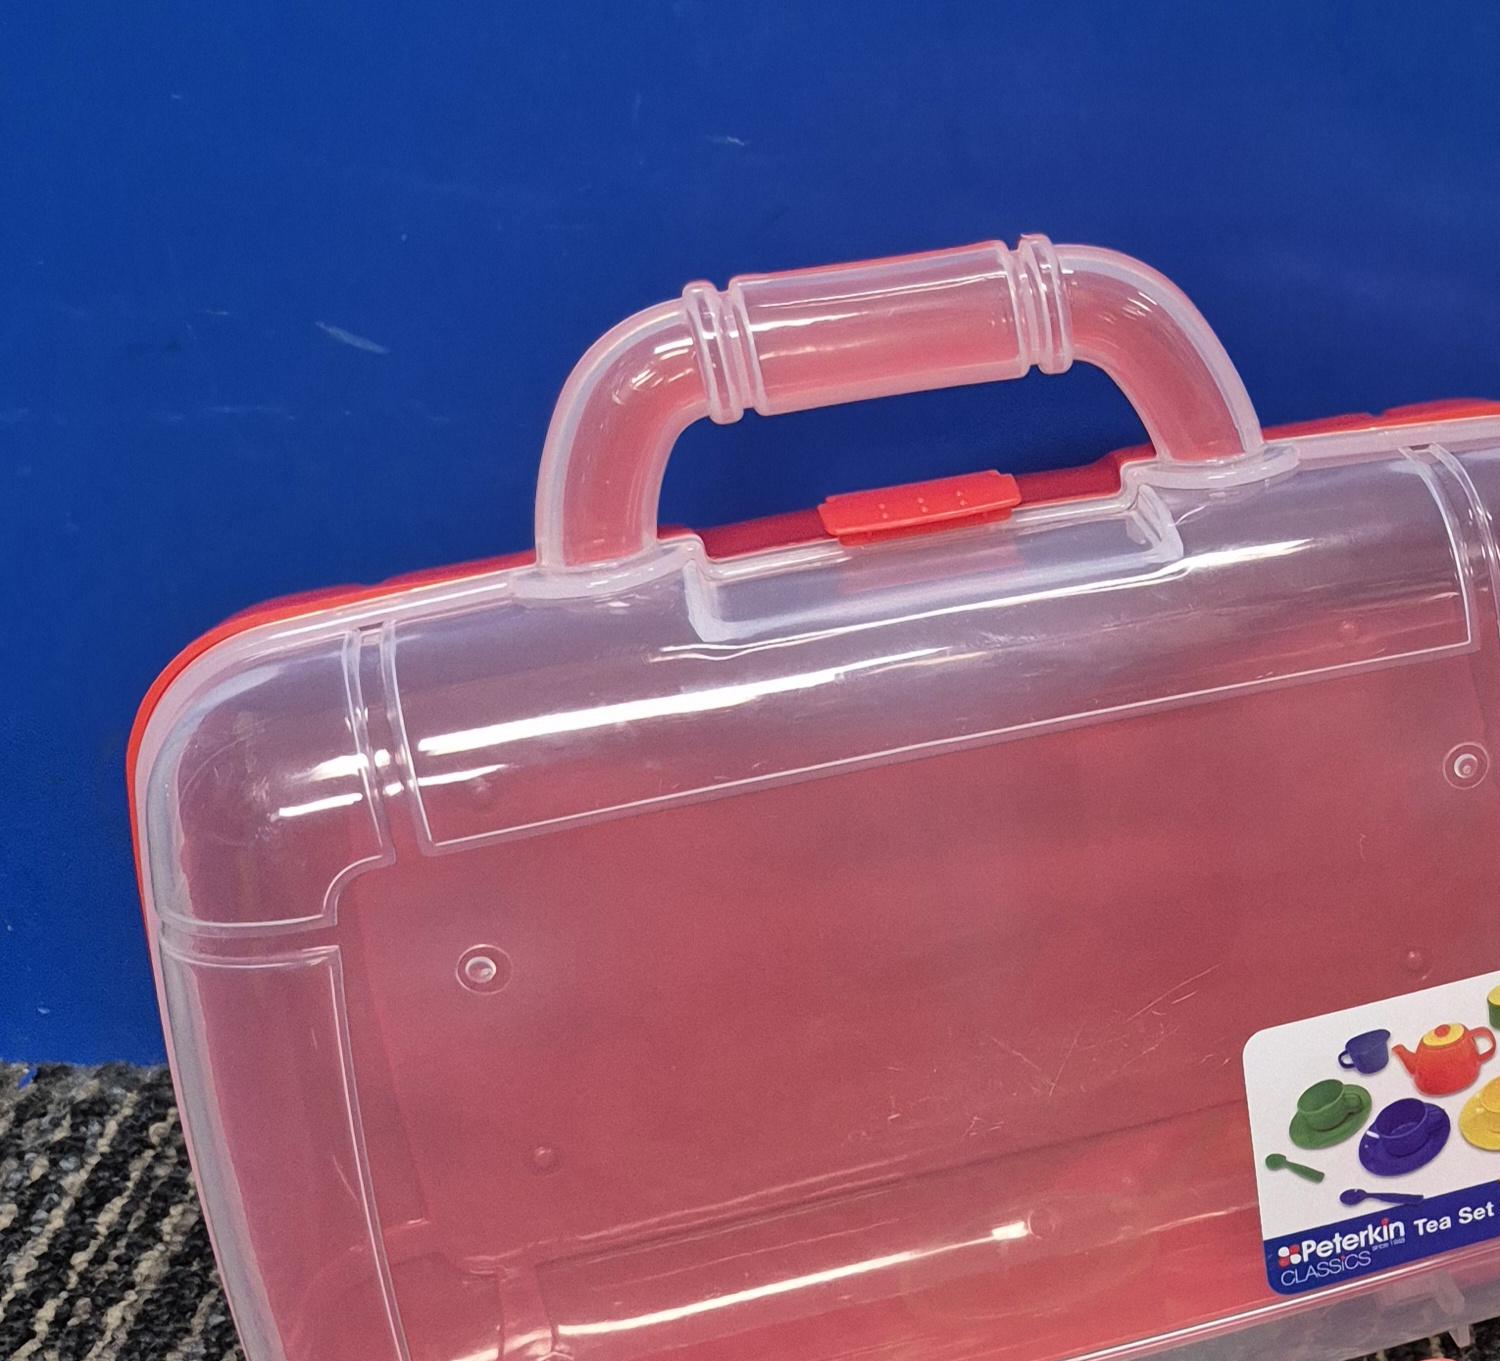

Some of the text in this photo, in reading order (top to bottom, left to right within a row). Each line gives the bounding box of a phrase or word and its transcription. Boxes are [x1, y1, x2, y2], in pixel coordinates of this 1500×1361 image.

[1413, 1215, 1452, 1236] Tea
[1458, 1201, 1495, 1225] Set
[1301, 1217, 1406, 1262] Peterkin
